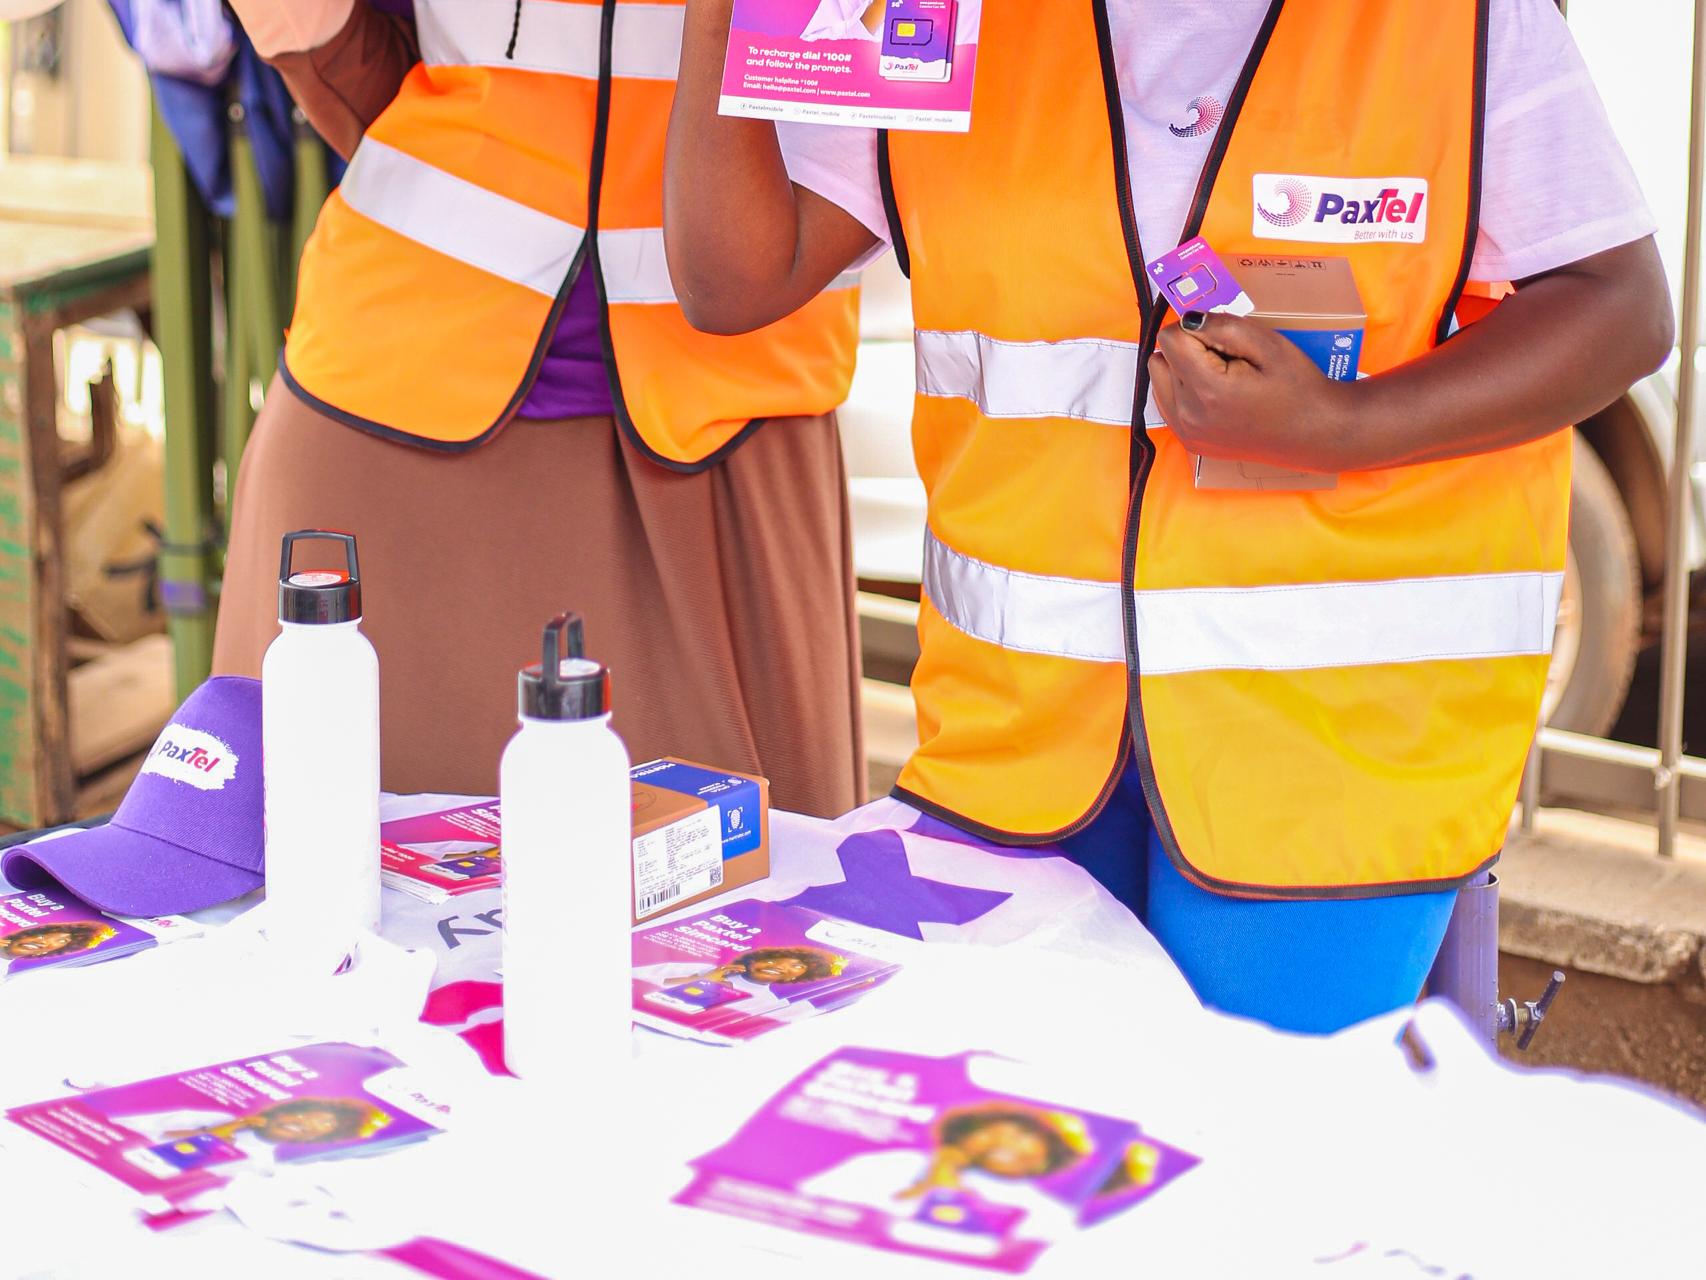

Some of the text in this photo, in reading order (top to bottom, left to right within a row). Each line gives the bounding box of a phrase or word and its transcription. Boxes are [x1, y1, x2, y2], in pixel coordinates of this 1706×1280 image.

[748, 46, 758, 55] To
[760, 48, 800, 60] recharge
[802, 51, 820, 60] dial
[746, 58, 764, 67] and
[765, 59, 793, 70] follow
[795, 61, 809, 71] the
[1313, 188, 1425, 224] PaxTel
[1354, 229, 1414, 241] Better with us
[158, 740, 221, 773] PaxTel
[26, 893, 57, 907] Buy
[4, 898, 51, 918] Paxtel
[709, 914, 749, 929] Buy
[692, 920, 753, 941] Paxtel
